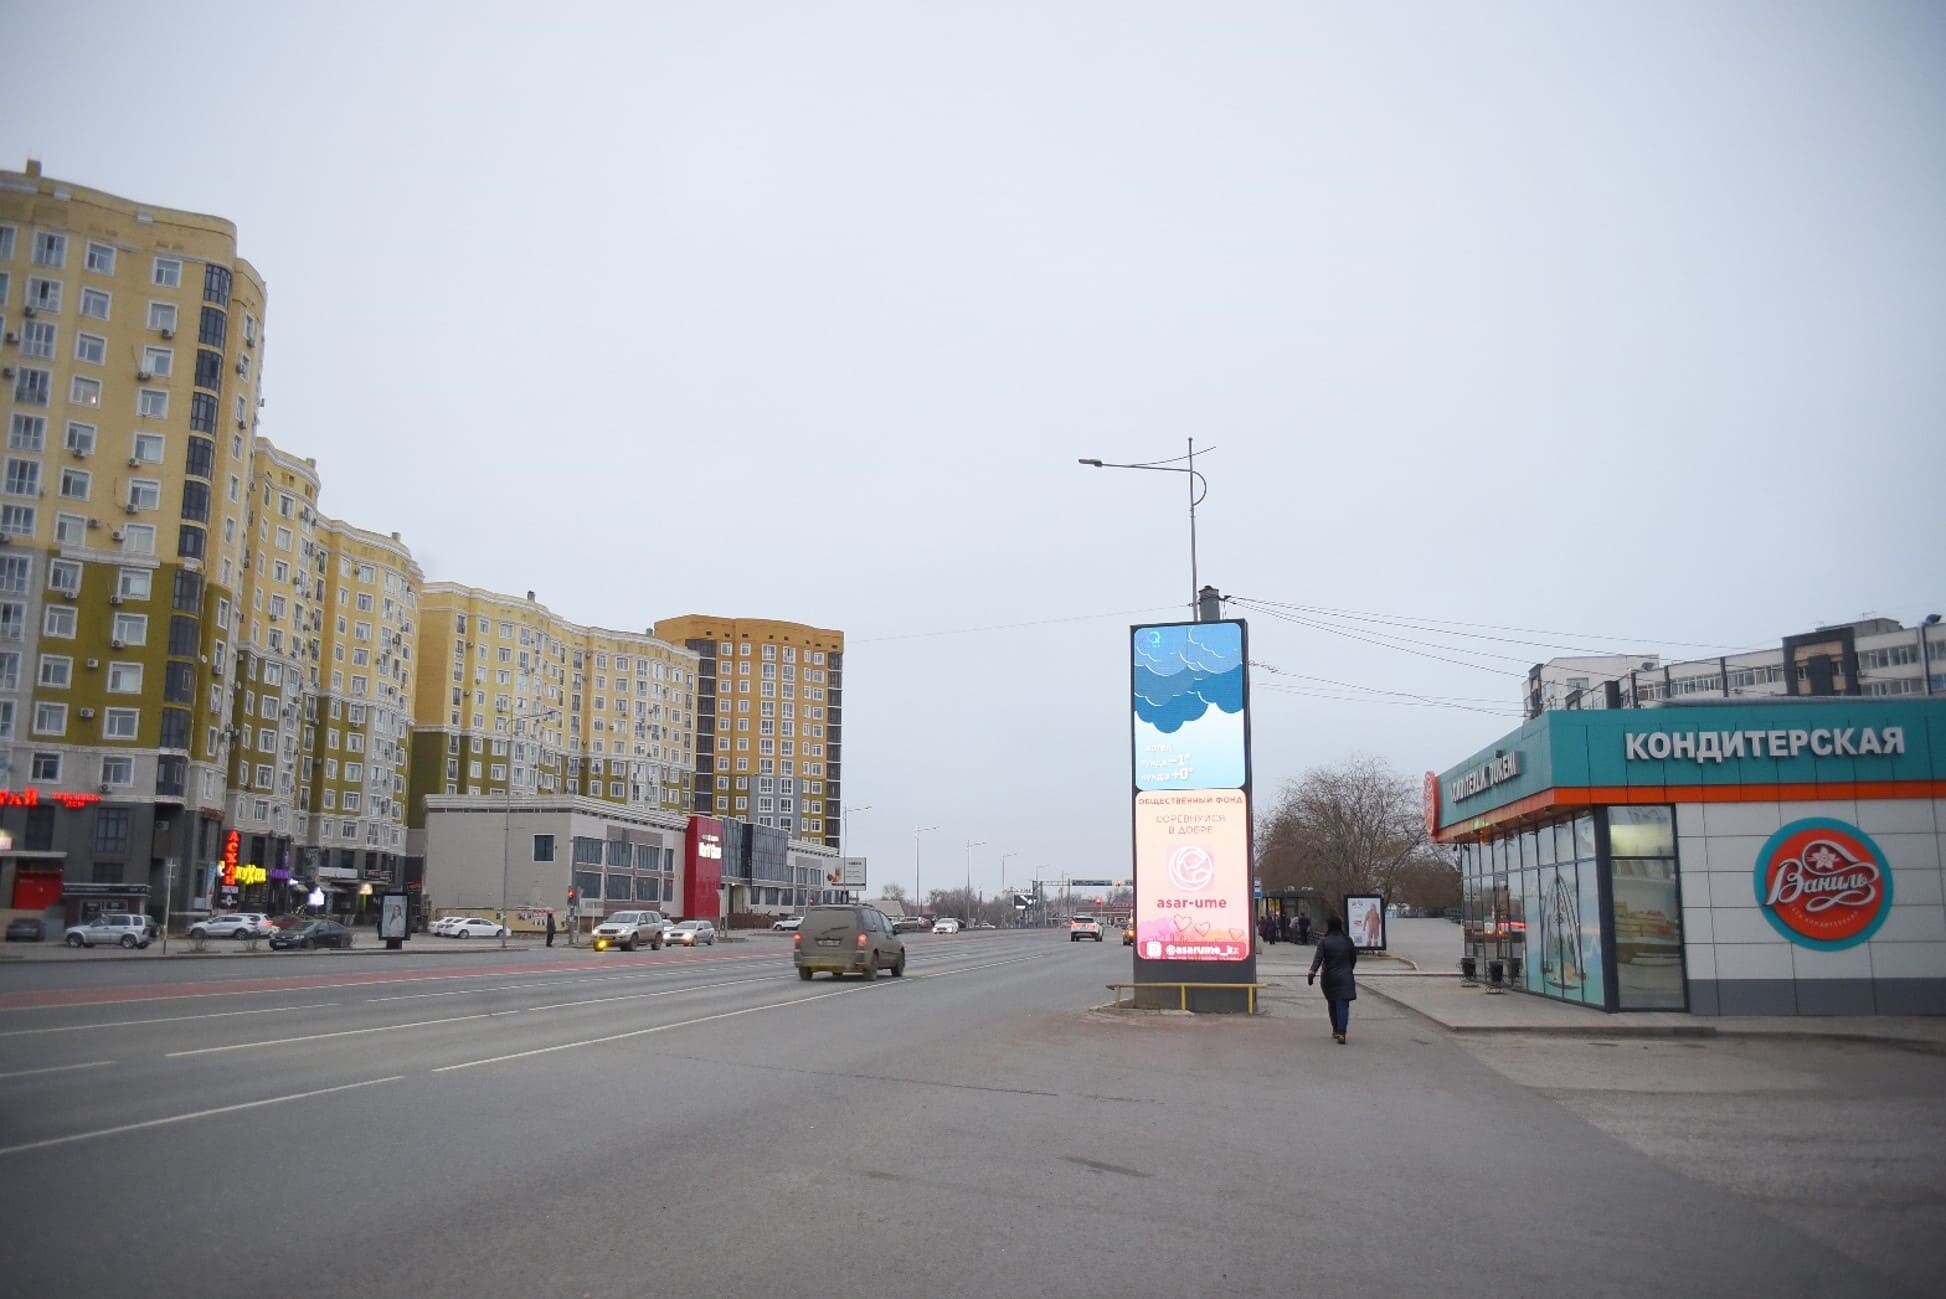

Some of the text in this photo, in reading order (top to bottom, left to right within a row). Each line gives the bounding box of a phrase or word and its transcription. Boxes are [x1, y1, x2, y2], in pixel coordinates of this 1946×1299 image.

[1625, 727, 1904, 764] КОНДИТЕРСКАЯ
[1138, 796, 1243, 806] ОБЩЕСТВЕННЫЙ ФОНД
[1764, 840, 1880, 912] Ваниль
[1156, 898, 1227, 909] asar-ume
